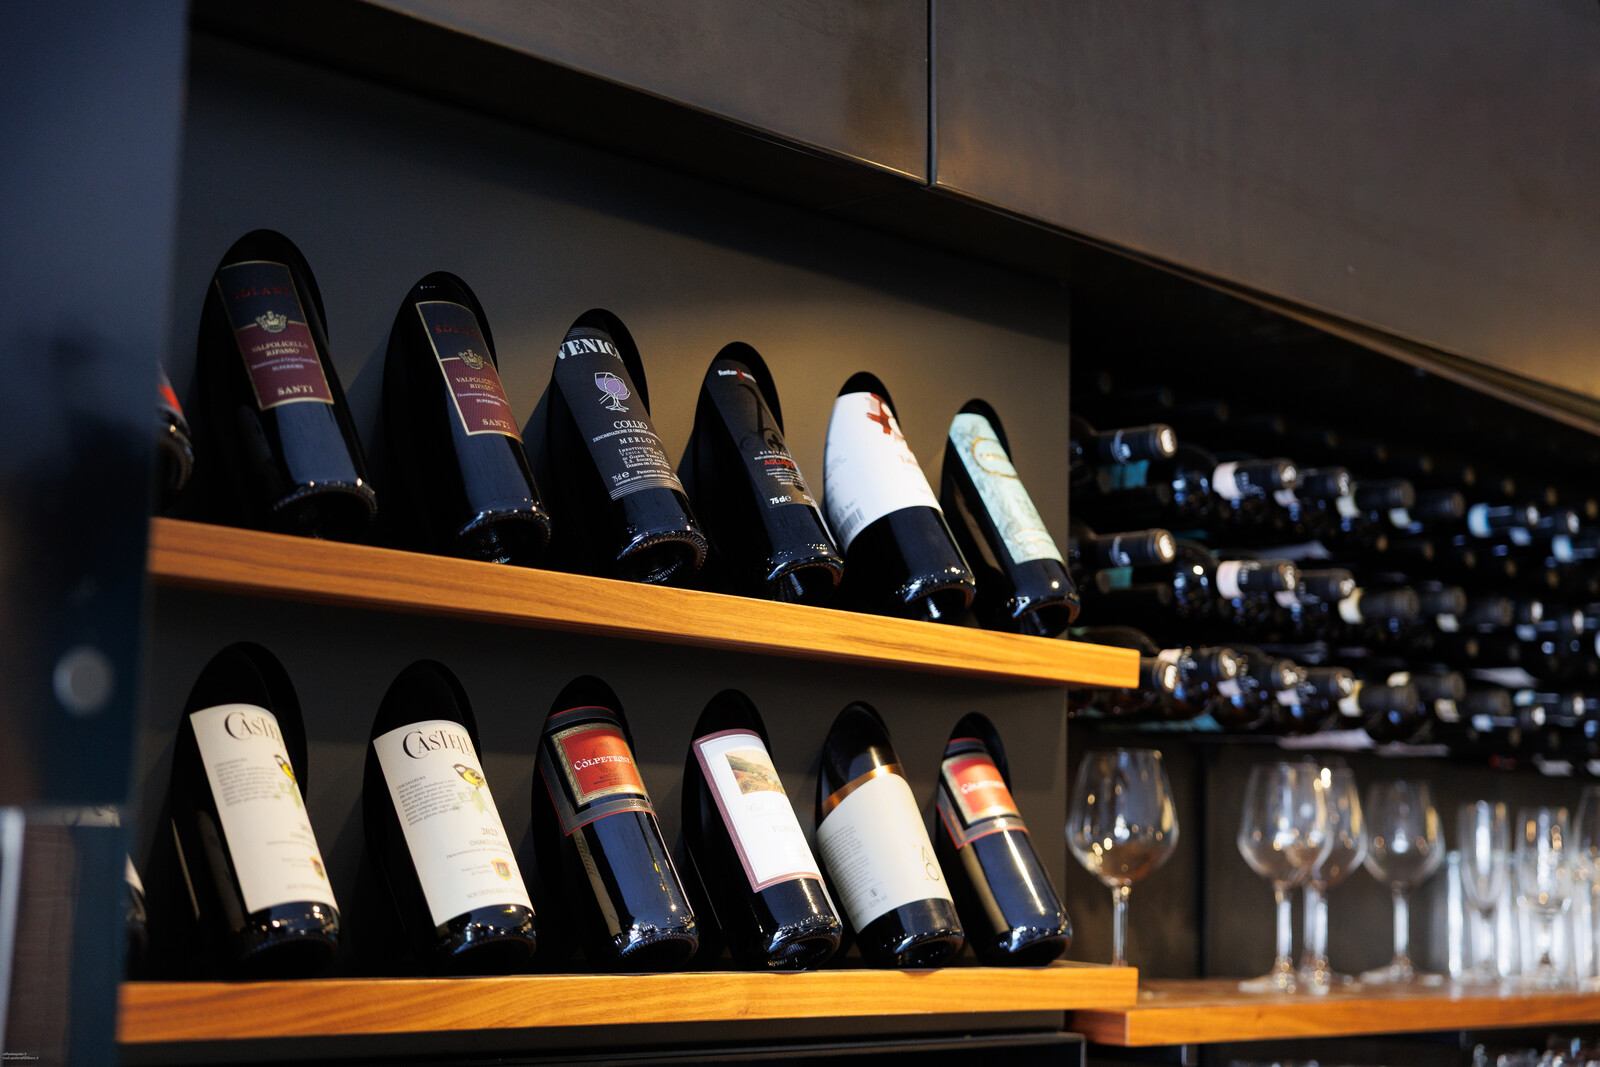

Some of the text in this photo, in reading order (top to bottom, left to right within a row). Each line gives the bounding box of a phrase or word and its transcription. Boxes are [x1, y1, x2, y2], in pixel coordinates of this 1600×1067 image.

[277, 384, 314, 396] SANTI
[482, 418, 511, 429] SANTI
[613, 420, 648, 430] COLLIO
[619, 436, 657, 446] MERLOT
